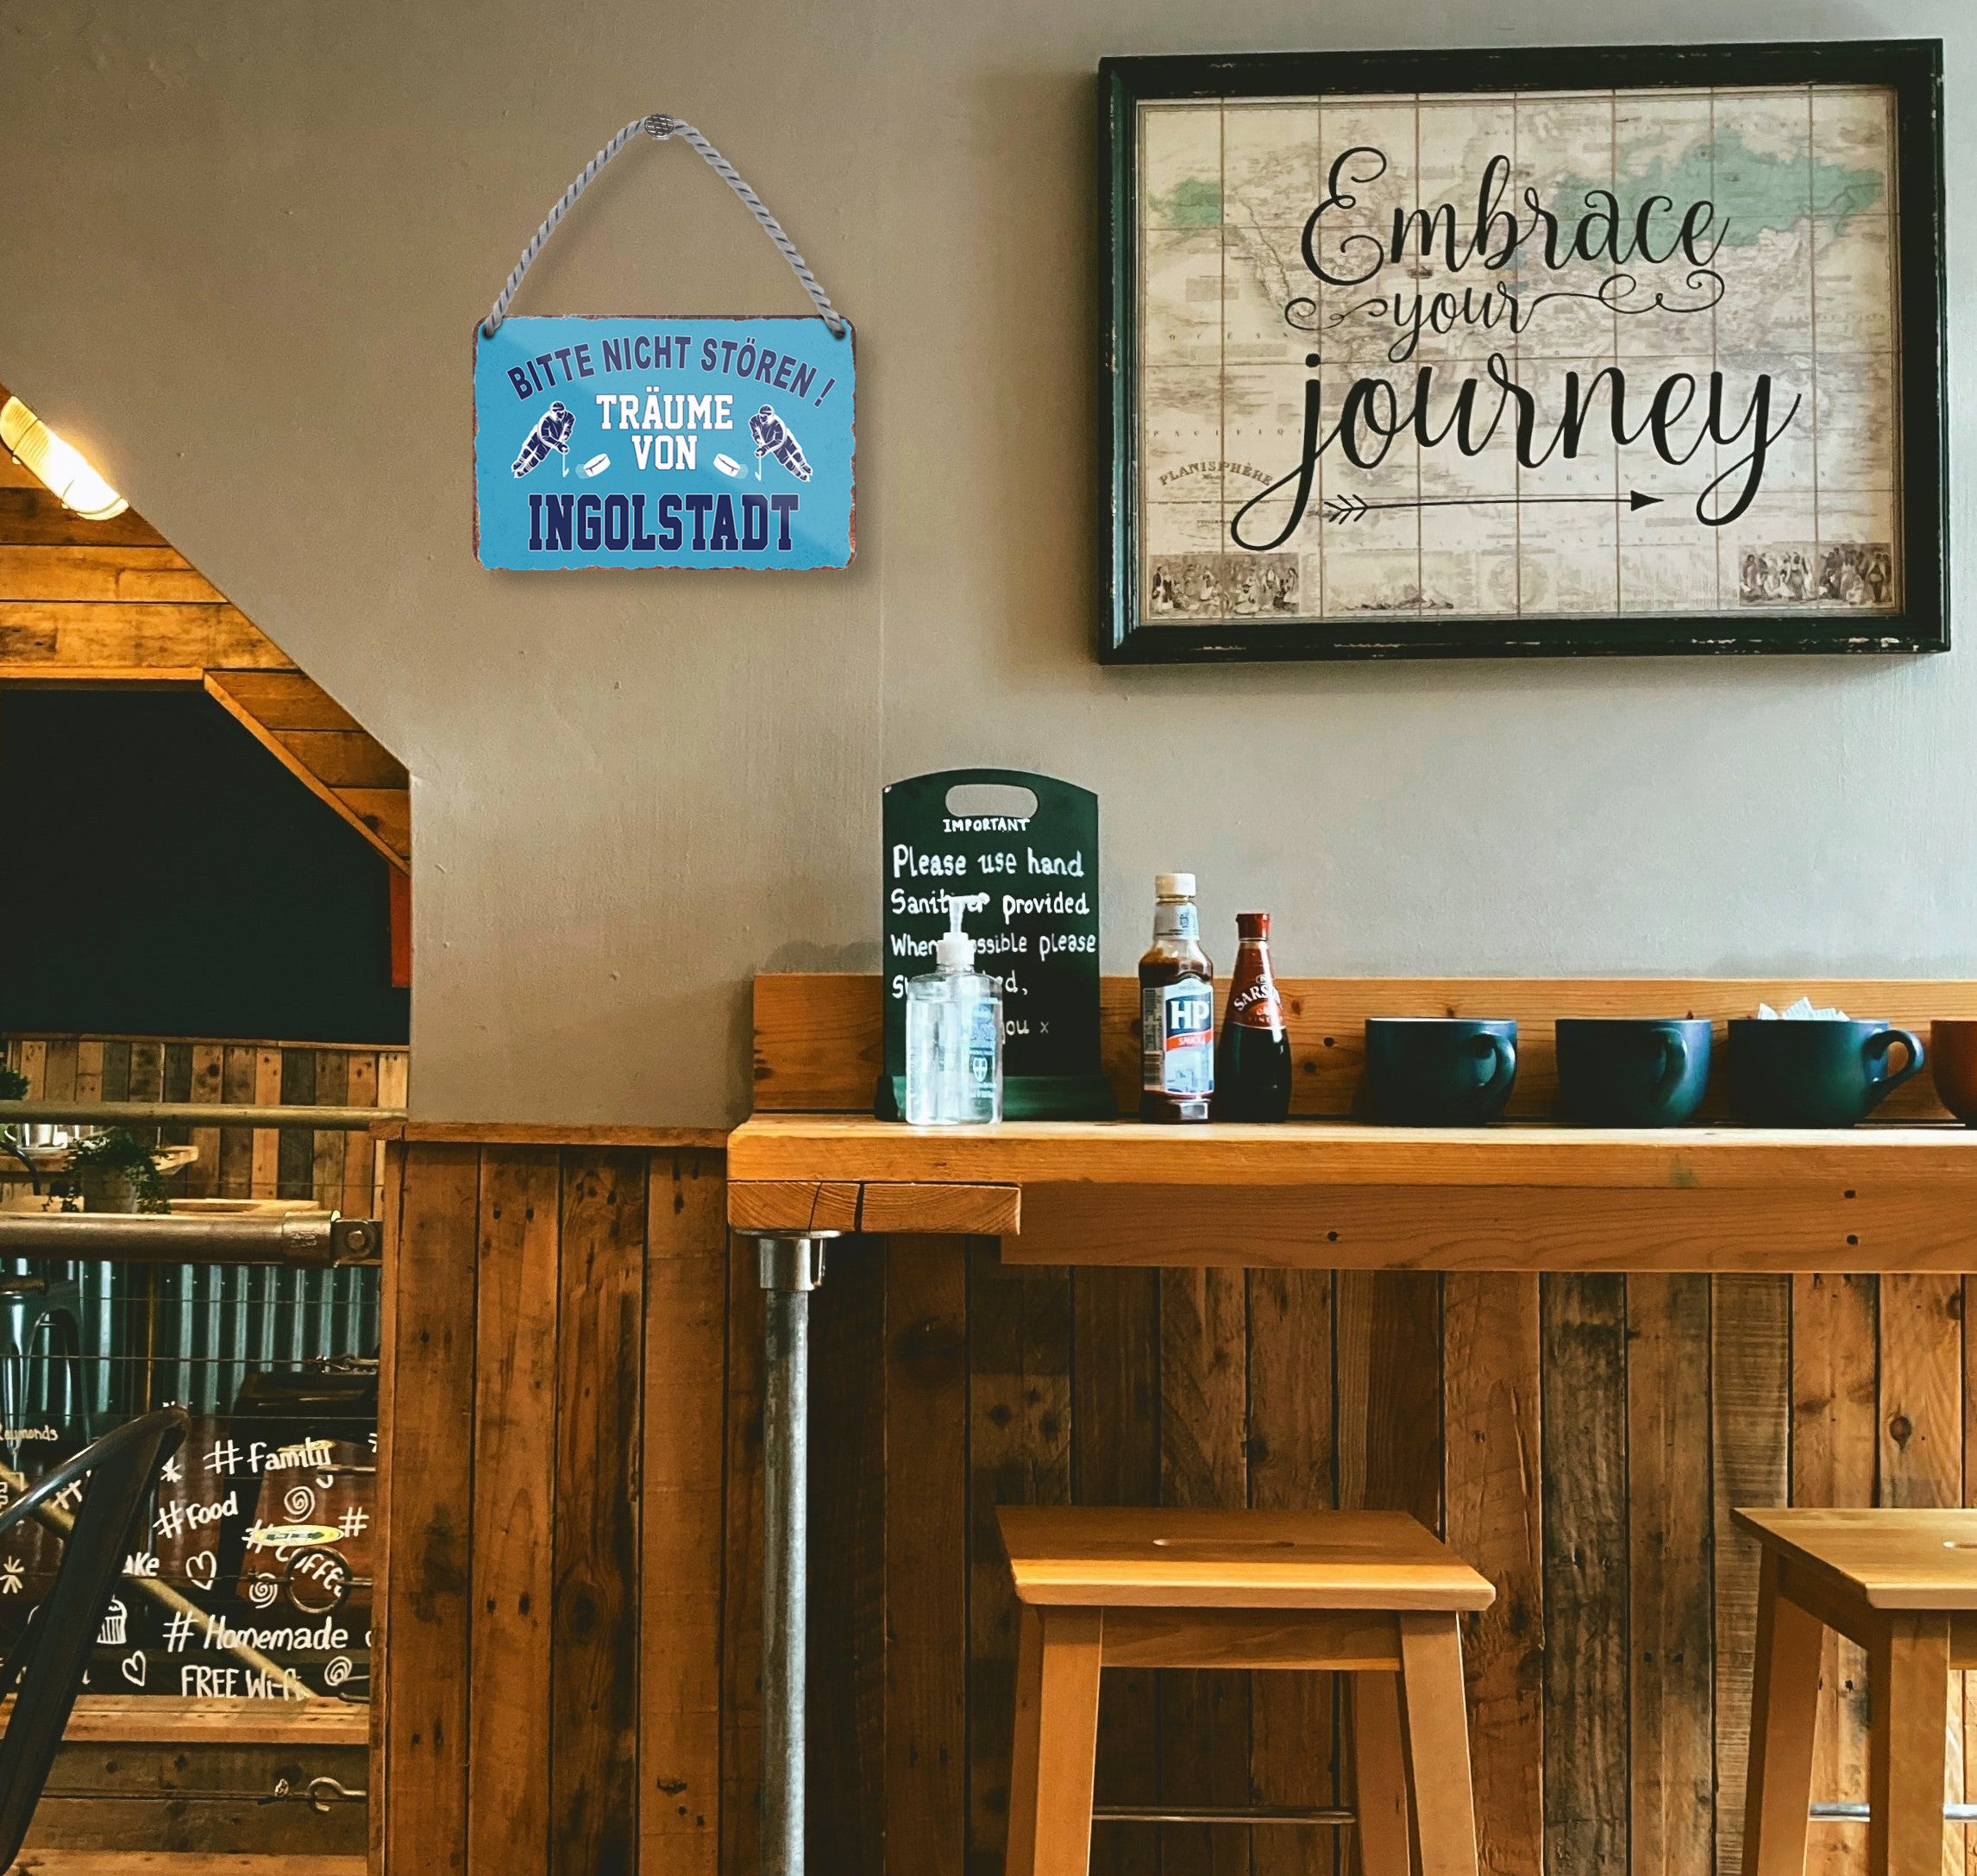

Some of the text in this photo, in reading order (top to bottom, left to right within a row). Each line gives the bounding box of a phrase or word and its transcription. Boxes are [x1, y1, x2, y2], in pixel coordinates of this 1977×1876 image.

[1301, 147, 1730, 285] Embrace
[1387, 280, 1541, 362] your
[506, 342, 595, 400] BITTE
[601, 336, 692, 373] NICHT
[700, 337, 817, 399] STÖREN
[595, 386, 734, 430] TRÄUME
[631, 435, 699, 471] VON
[1231, 352, 1802, 551] journey
[528, 493, 799, 551] INGOLSTADT
[943, 818, 1031, 833] IMPORTANT
[893, 844, 1084, 878] Please use hand
[1002, 892, 1090, 925] provided
[890, 933, 939, 957] Wher
[1039, 933, 1096, 962] please
[1171, 1001, 1209, 1029] HP
[181, 1665, 239, 1699] FREE
